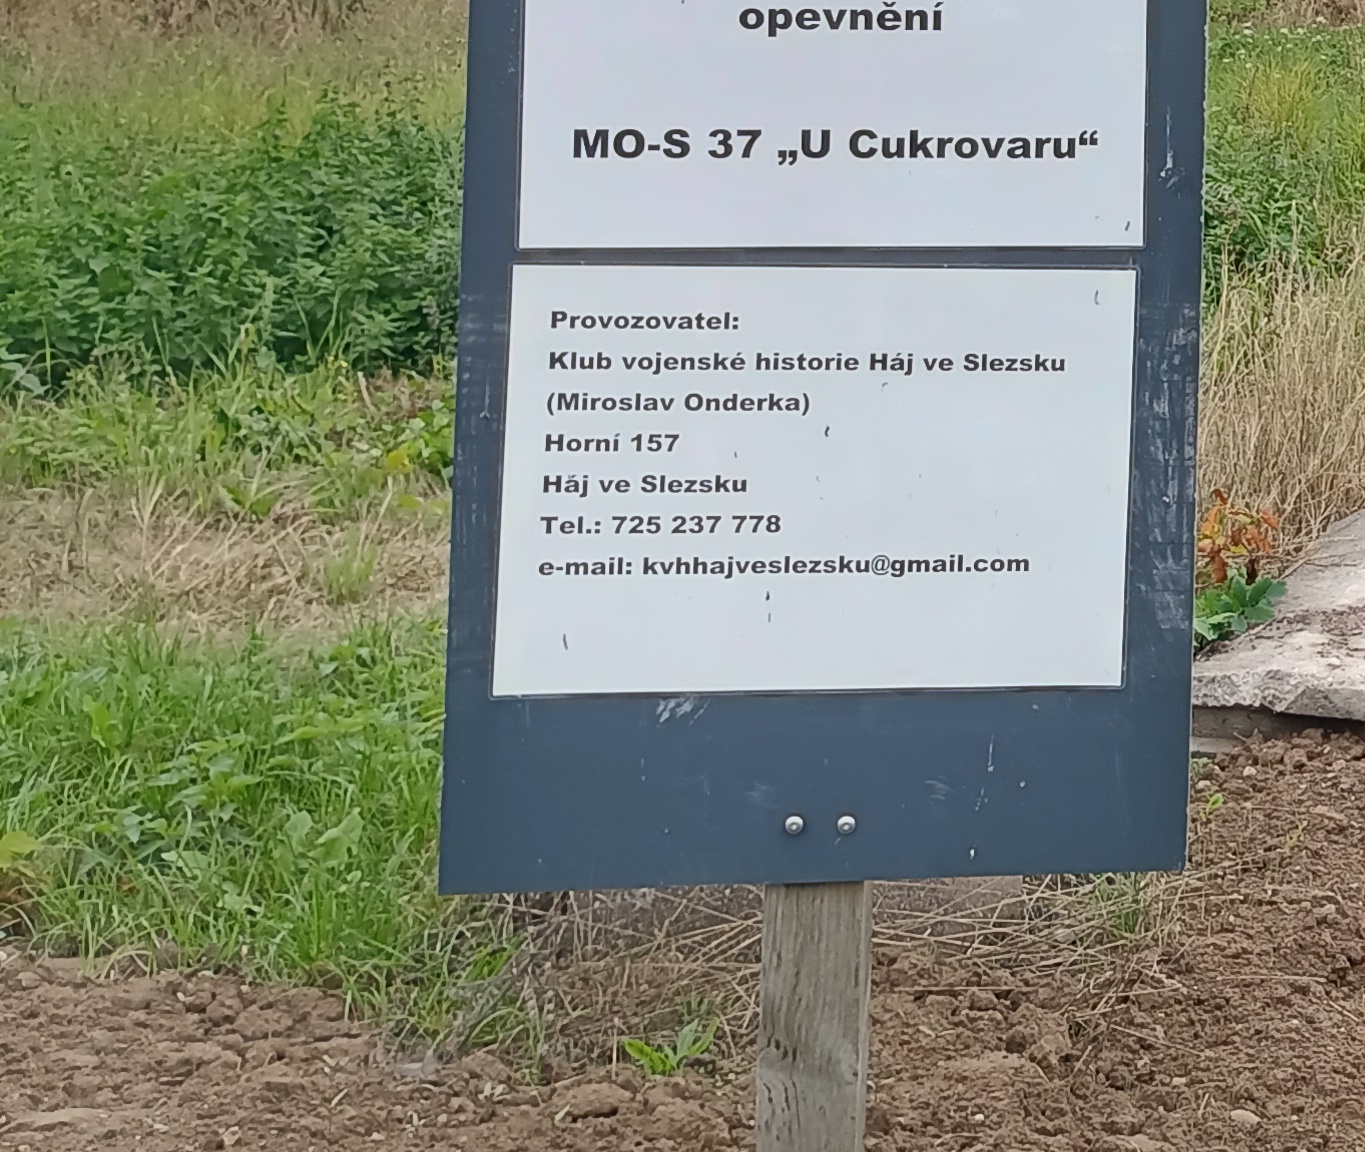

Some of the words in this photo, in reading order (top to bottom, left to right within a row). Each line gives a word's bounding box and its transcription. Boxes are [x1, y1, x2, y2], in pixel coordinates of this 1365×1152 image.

[739, 2, 943, 37] opevnění
[573, 129, 690, 158] MO-S
[708, 129, 761, 158] 37
[551, 311, 739, 330] Provozovatel:
[549, 352, 611, 370] Klub
[622, 352, 746, 374] vojenské
[756, 353, 859, 371] historie
[870, 353, 913, 375] Háj
[923, 358, 954, 372] ve
[964, 354, 1066, 372] Slezsku
[547, 393, 674, 415] (Miroslav
[685, 393, 810, 415] Onderka)
[545, 434, 619, 452] Horní
[631, 434, 679, 452] 157
[543, 475, 588, 497] Háj
[599, 480, 630, 494] ve
[641, 475, 747, 493] Slezsku
[541, 516, 601, 534] Tel.:
[612, 516, 661, 534] 725
[672, 516, 721, 534] 237
[732, 515, 781, 533] 778
[539, 557, 632, 575] e-mail:
[643, 555, 1030, 580] kvhhajveslezsku@gmail.com
